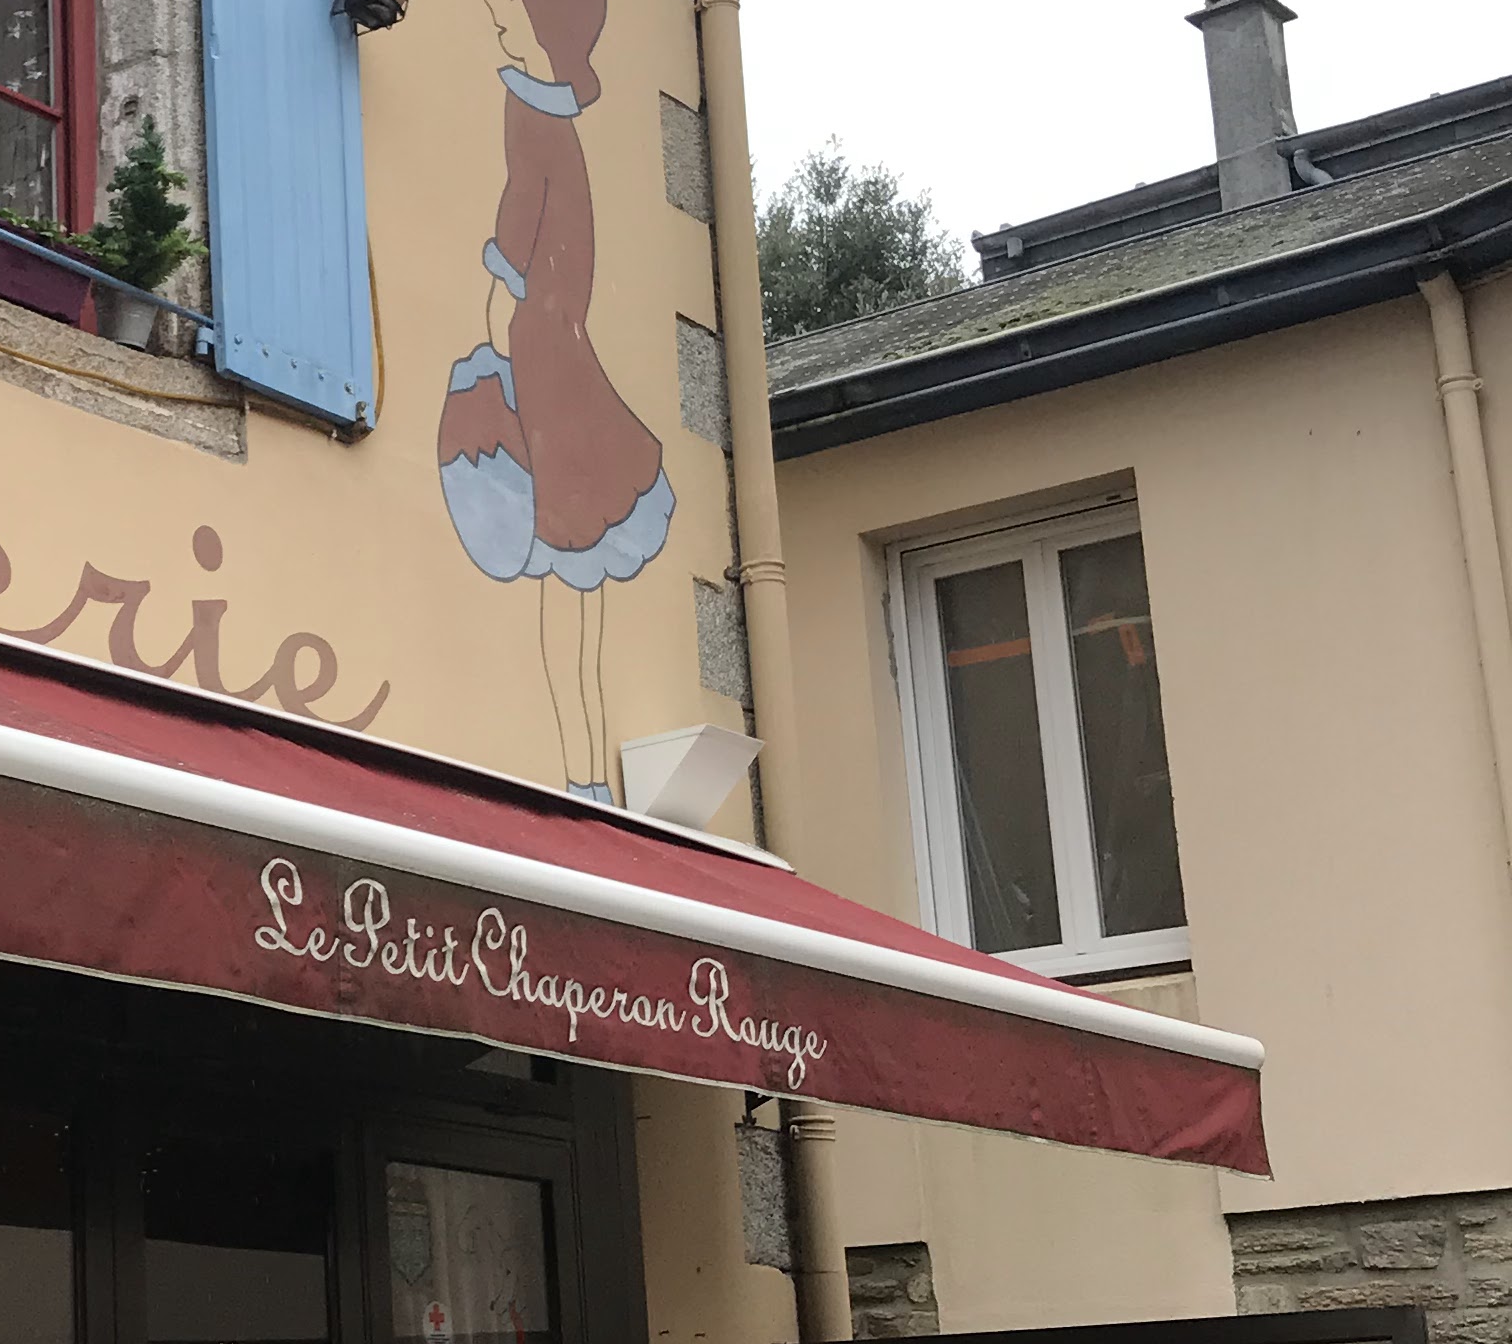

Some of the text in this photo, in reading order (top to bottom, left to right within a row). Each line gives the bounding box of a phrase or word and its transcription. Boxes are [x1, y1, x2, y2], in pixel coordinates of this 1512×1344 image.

[254, 857, 827, 1090] Le Petit Chaperon Rouge
